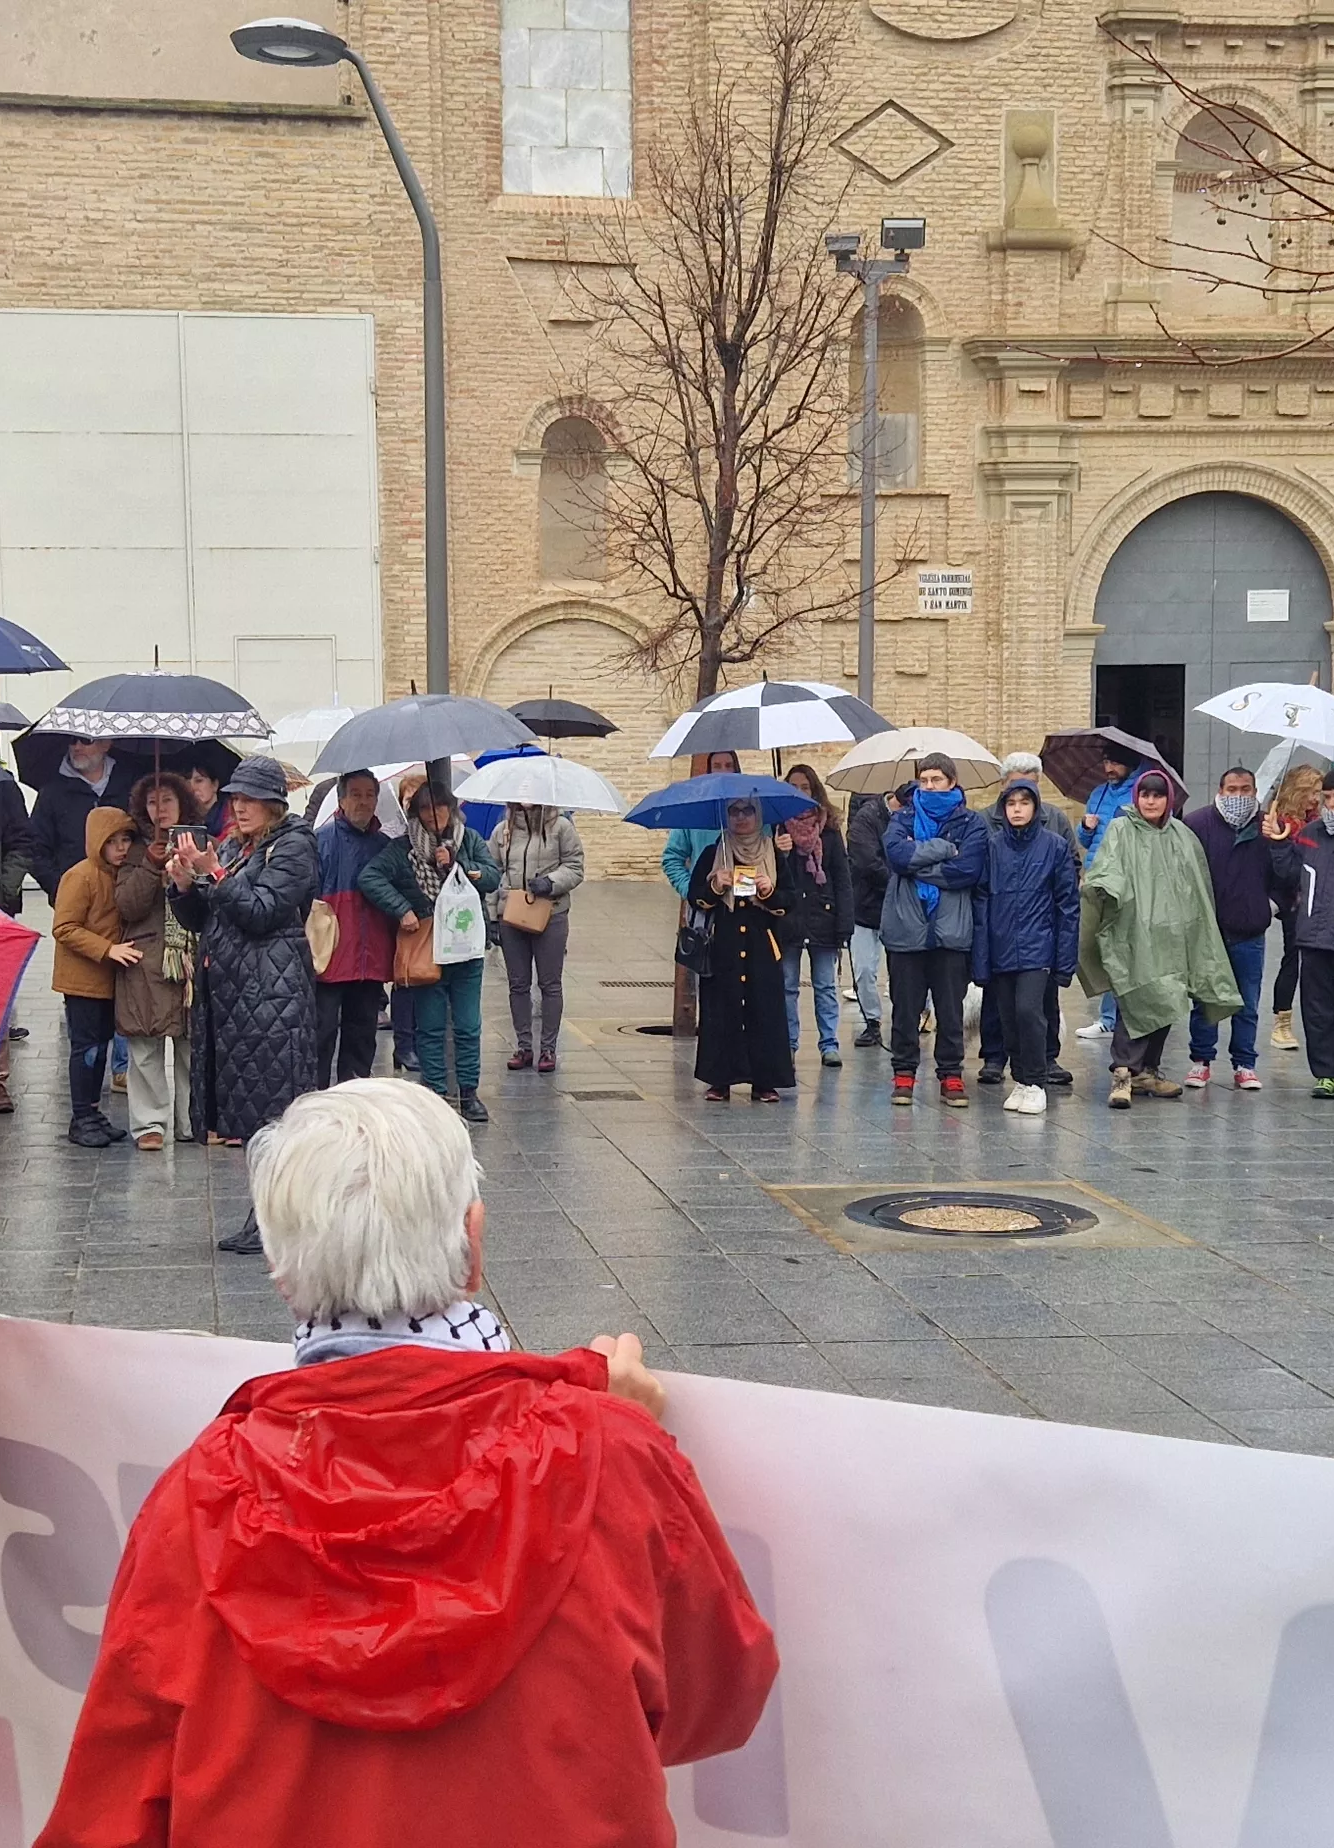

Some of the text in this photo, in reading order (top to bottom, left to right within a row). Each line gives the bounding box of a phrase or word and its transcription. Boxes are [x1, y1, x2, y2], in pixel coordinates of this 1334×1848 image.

[927, 587, 947, 596] SANTO
[929, 600, 942, 609] SAN
[1228, 692, 1261, 710] S
